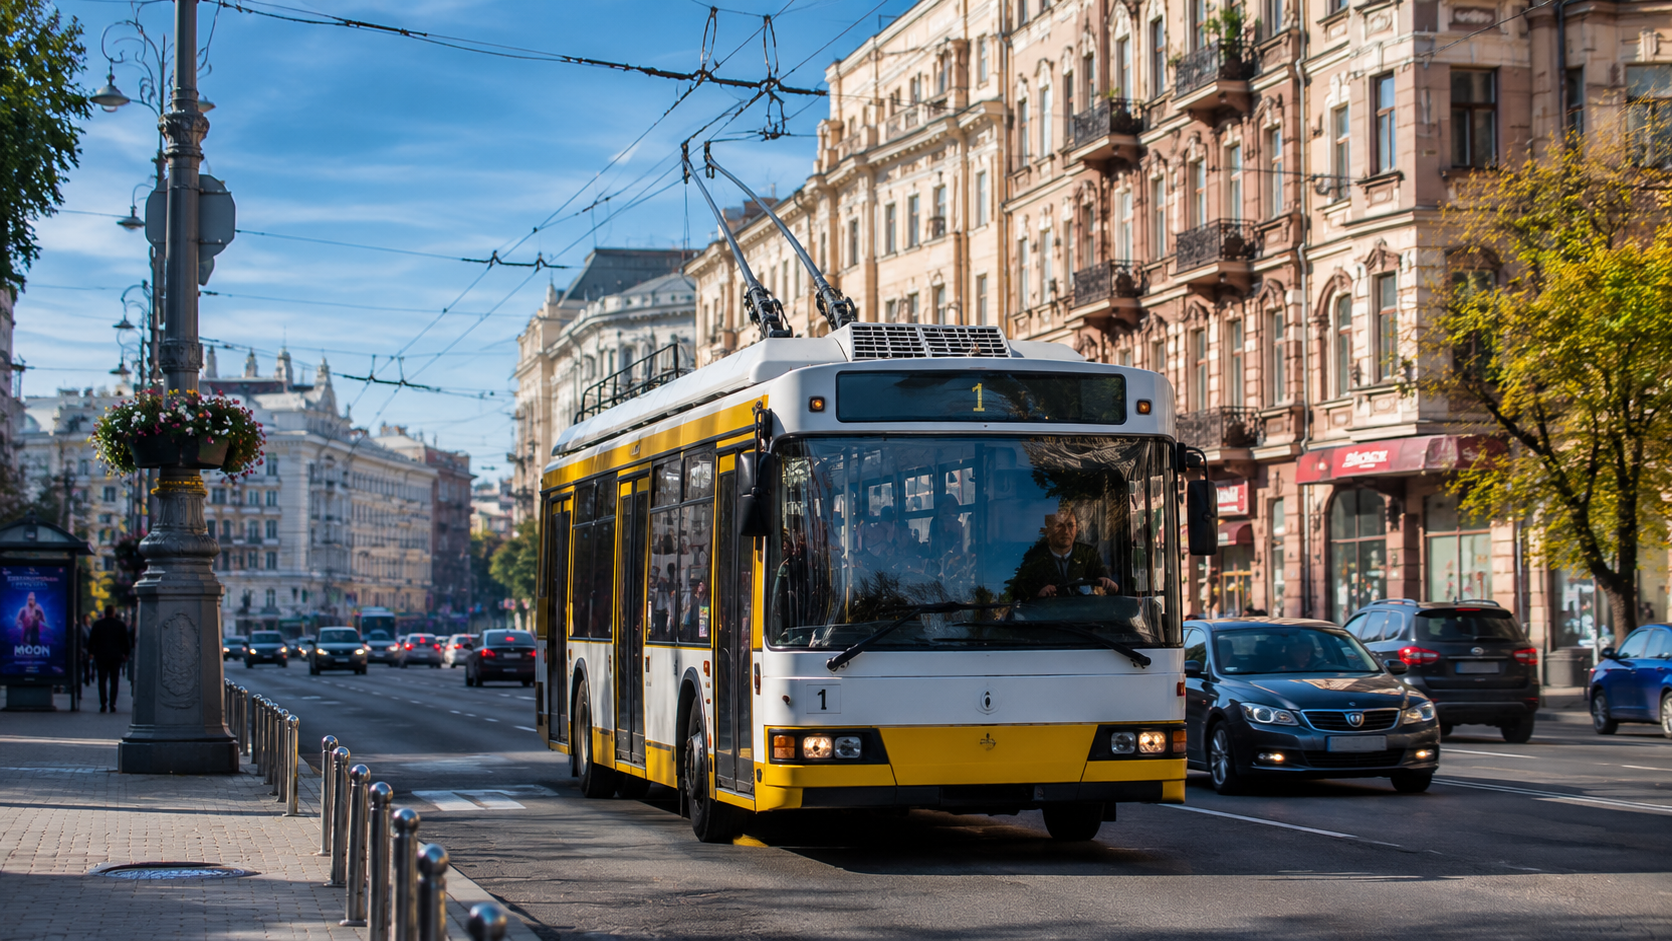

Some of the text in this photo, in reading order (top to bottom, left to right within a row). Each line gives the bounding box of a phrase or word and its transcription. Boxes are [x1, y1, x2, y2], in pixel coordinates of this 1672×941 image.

[972, 383, 985, 411] 1
[14, 645, 50, 657] MOON
[817, 689, 827, 710] 1
